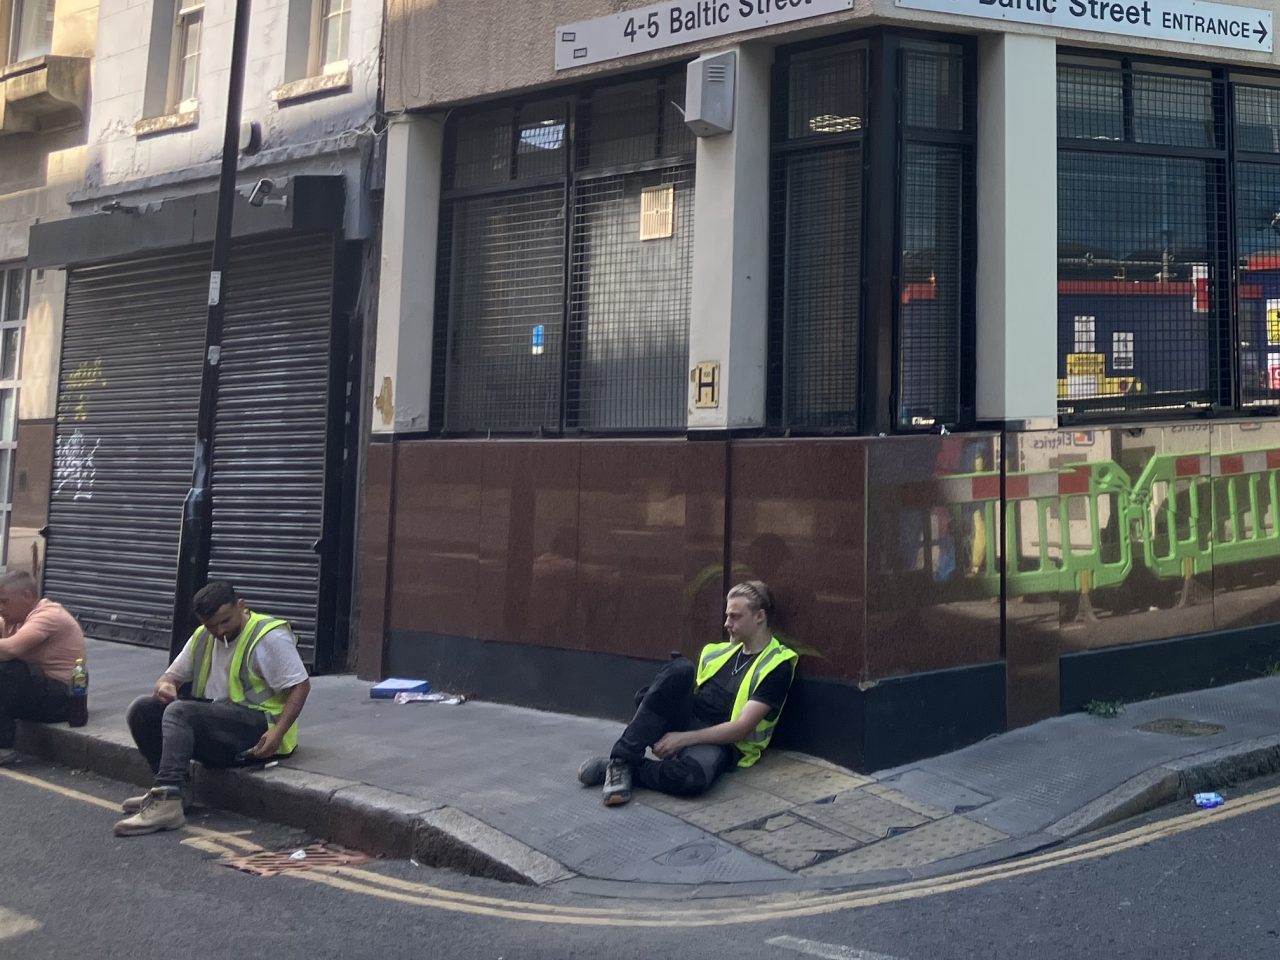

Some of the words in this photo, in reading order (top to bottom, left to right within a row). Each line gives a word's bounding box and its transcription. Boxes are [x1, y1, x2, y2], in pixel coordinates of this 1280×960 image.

[623, 11, 660, 43] 4-5
[669, 0, 730, 34] Baltic
[1162, 11, 1250, 39] ENTRANCE
[698, 366, 715, 402] H
